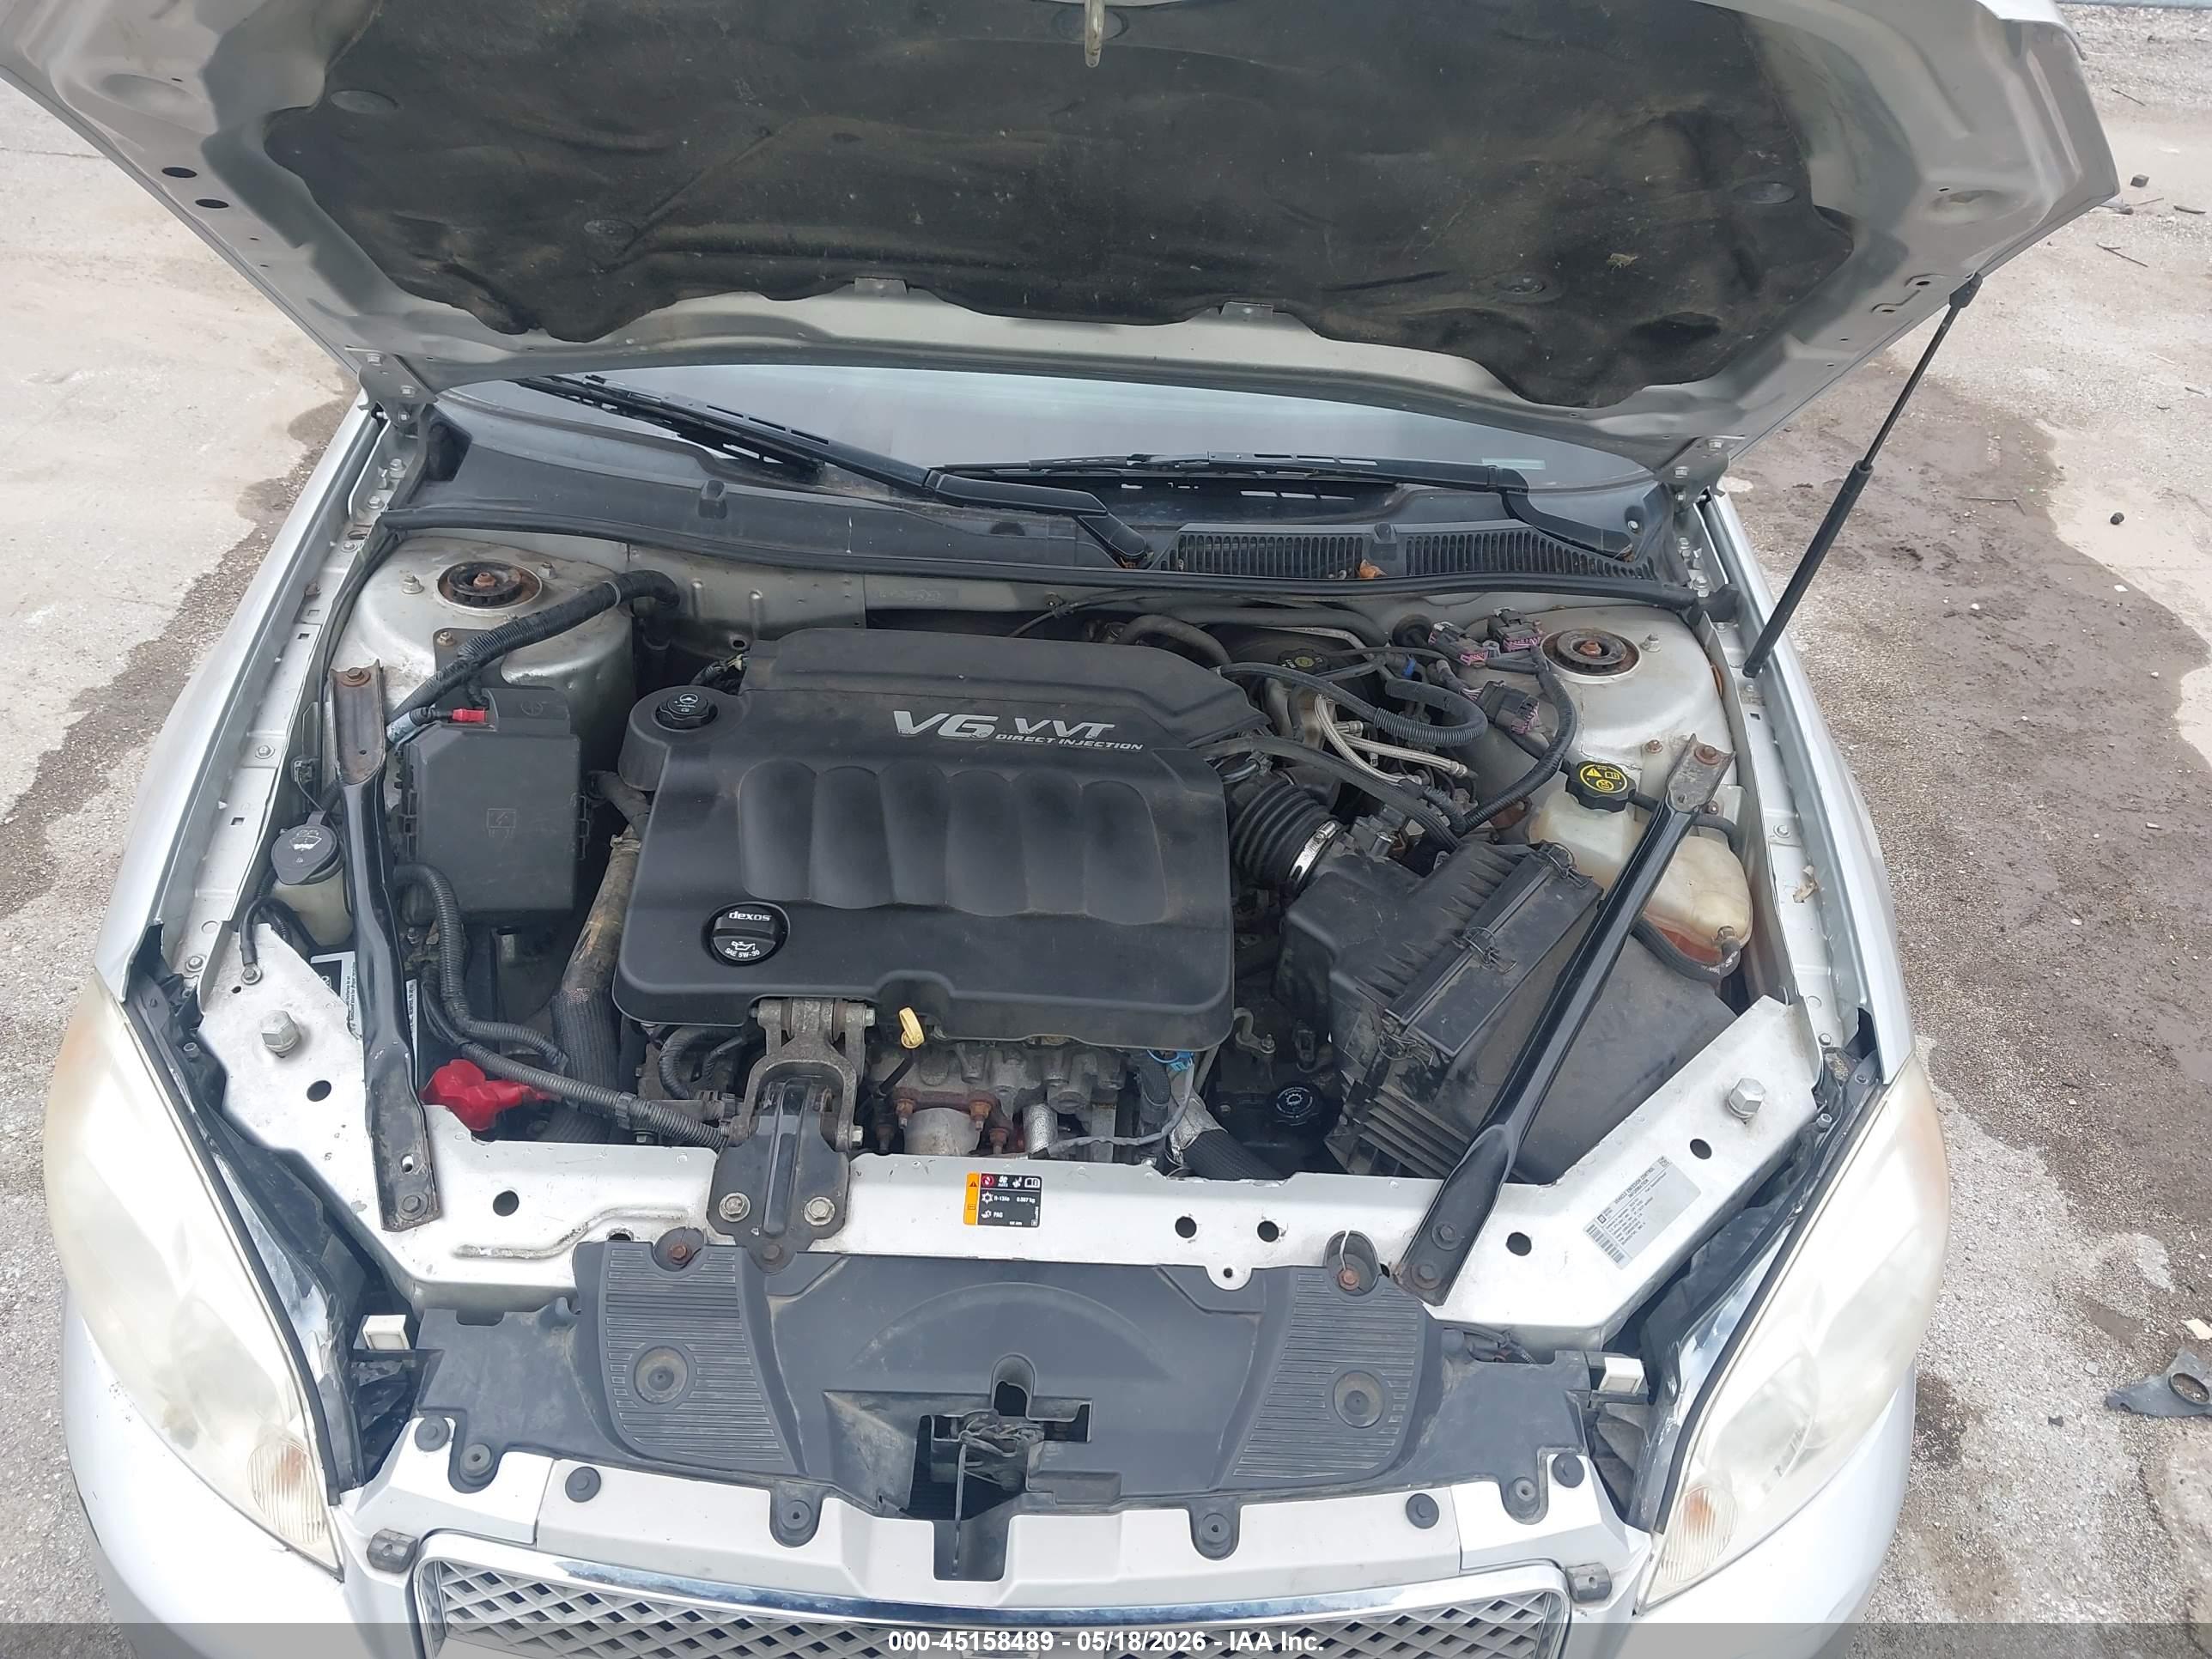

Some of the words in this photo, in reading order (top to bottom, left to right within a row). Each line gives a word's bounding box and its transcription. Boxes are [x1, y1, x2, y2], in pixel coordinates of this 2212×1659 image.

[893, 710, 1000, 739] V6
[1014, 717, 1116, 739] VVT
[994, 733, 1057, 744] DIRECT
[1058, 738, 1144, 751] INJECTION
[728, 911, 772, 921] dexos
[724, 947, 738, 957] SAE
[738, 950, 761, 958] 5W-30
